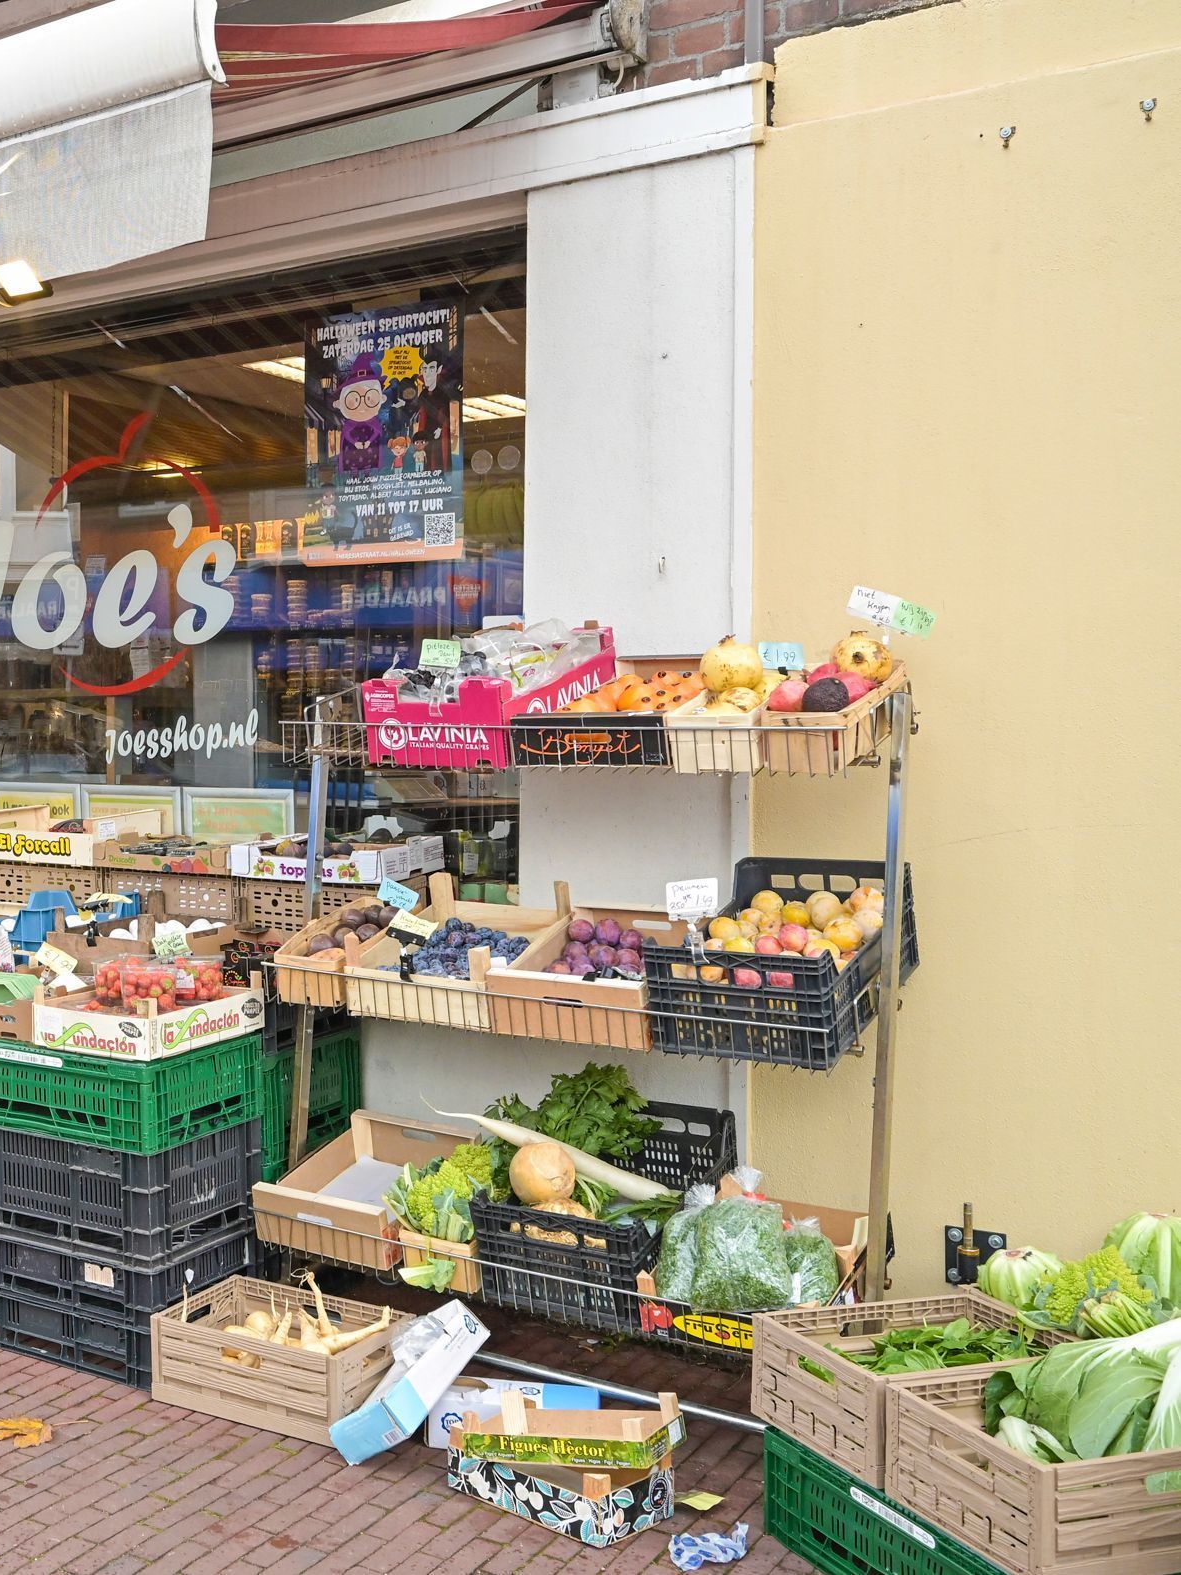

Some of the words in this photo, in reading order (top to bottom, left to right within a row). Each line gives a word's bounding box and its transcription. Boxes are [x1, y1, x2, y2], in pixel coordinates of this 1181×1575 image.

[316, 321, 376, 342] HALLOWEEN
[378, 308, 451, 332] SPEURTOCHT!
[322, 342, 375, 359] ZATERDAG
[377, 337, 391, 351] 25
[393, 329, 443, 347] OKTOBER
[346, 477, 361, 485] HAAL
[363, 476, 379, 484] JOUW
[372, 482, 406, 490] HOOGVLIET,
[370, 491, 392, 499] ALBERT
[424, 486, 452, 494] LUCIANO
[356, 504, 374, 517] VAN
[377, 502, 386, 515] 11
[388, 501, 406, 514] TOT
[408, 499, 420, 512] 17
[422, 498, 444, 512] UUR
[545, 671, 601, 714] LAVINIA
[408, 724, 489, 744] LAVINIA
[51, 804, 70, 817] ook
[12, 833, 72, 857] Forcall
[498, 1435, 548, 1455] Figues
[552, 1439, 605, 1457] Hèctor
